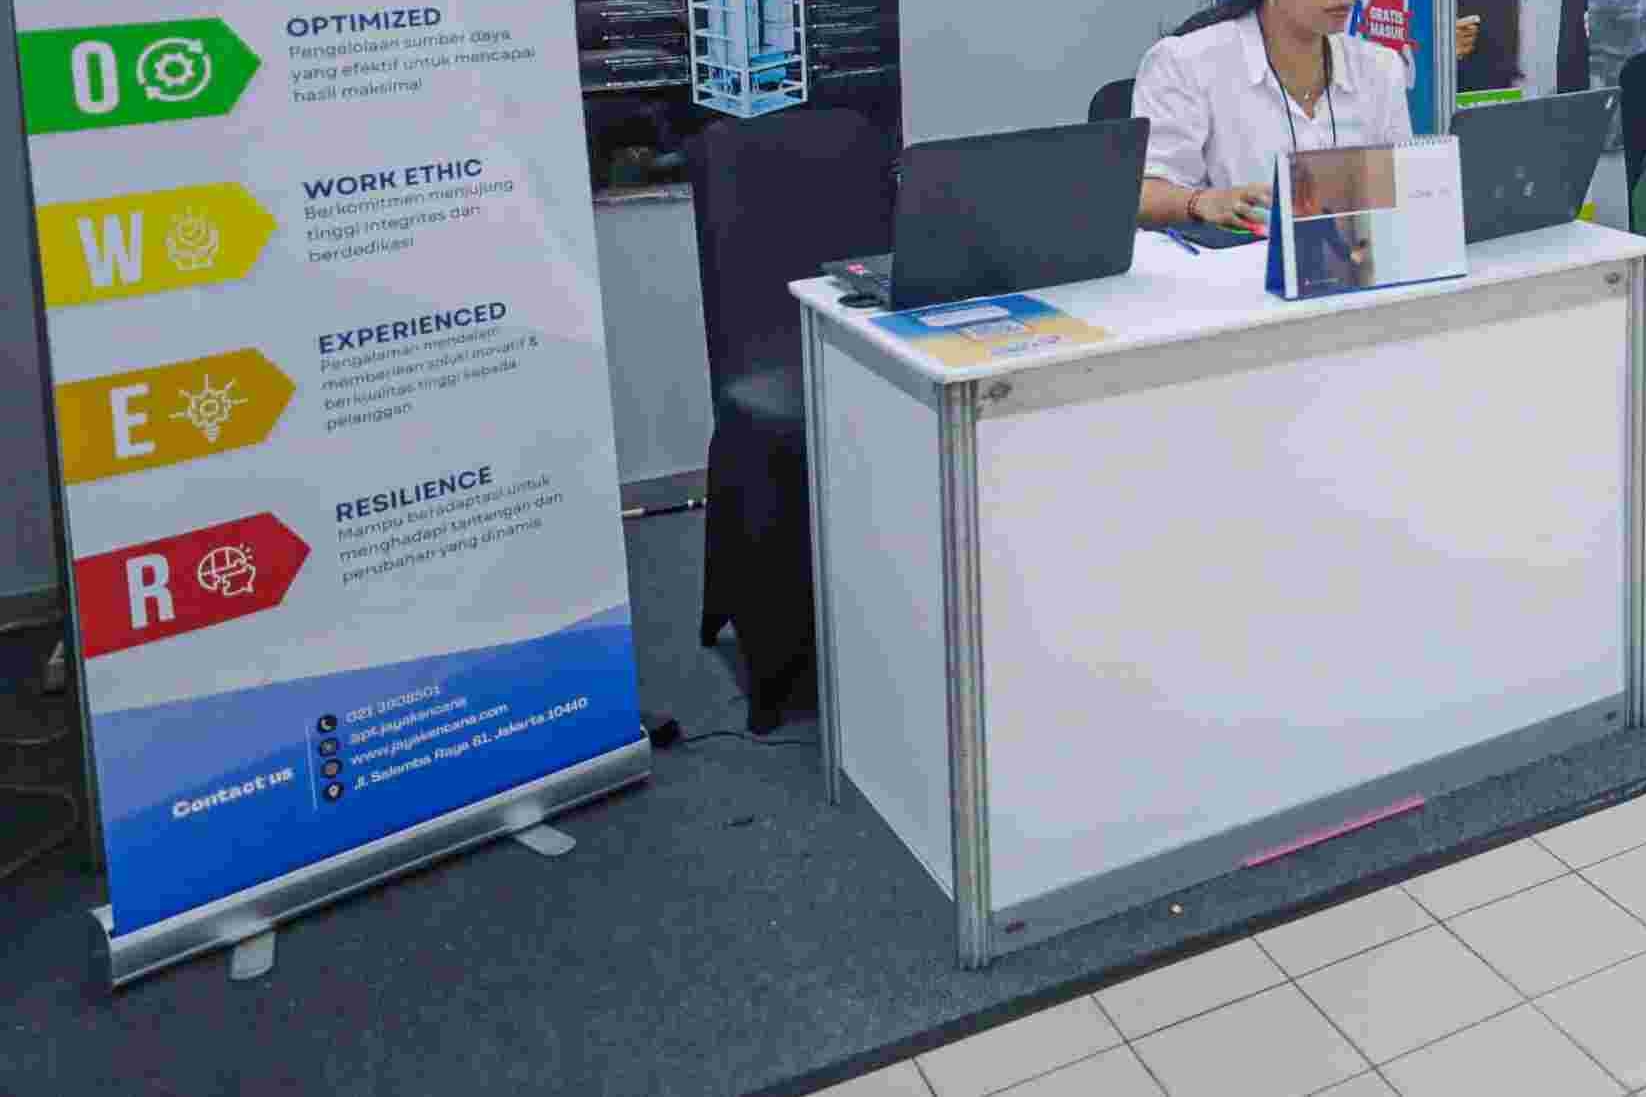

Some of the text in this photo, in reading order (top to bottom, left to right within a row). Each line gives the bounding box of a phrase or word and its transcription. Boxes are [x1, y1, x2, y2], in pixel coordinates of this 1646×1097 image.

[286, 7, 442, 38] OPTIMIZED
[70, 41, 119, 114] O
[304, 158, 484, 200] WORK ETHIC
[76, 211, 144, 289] W
[318, 301, 508, 356] EXPERIENCED
[107, 384, 157, 461] E
[335, 464, 495, 522] RESILIENCE
[126, 553, 177, 630] R
[172, 766, 295, 820] Contact us
